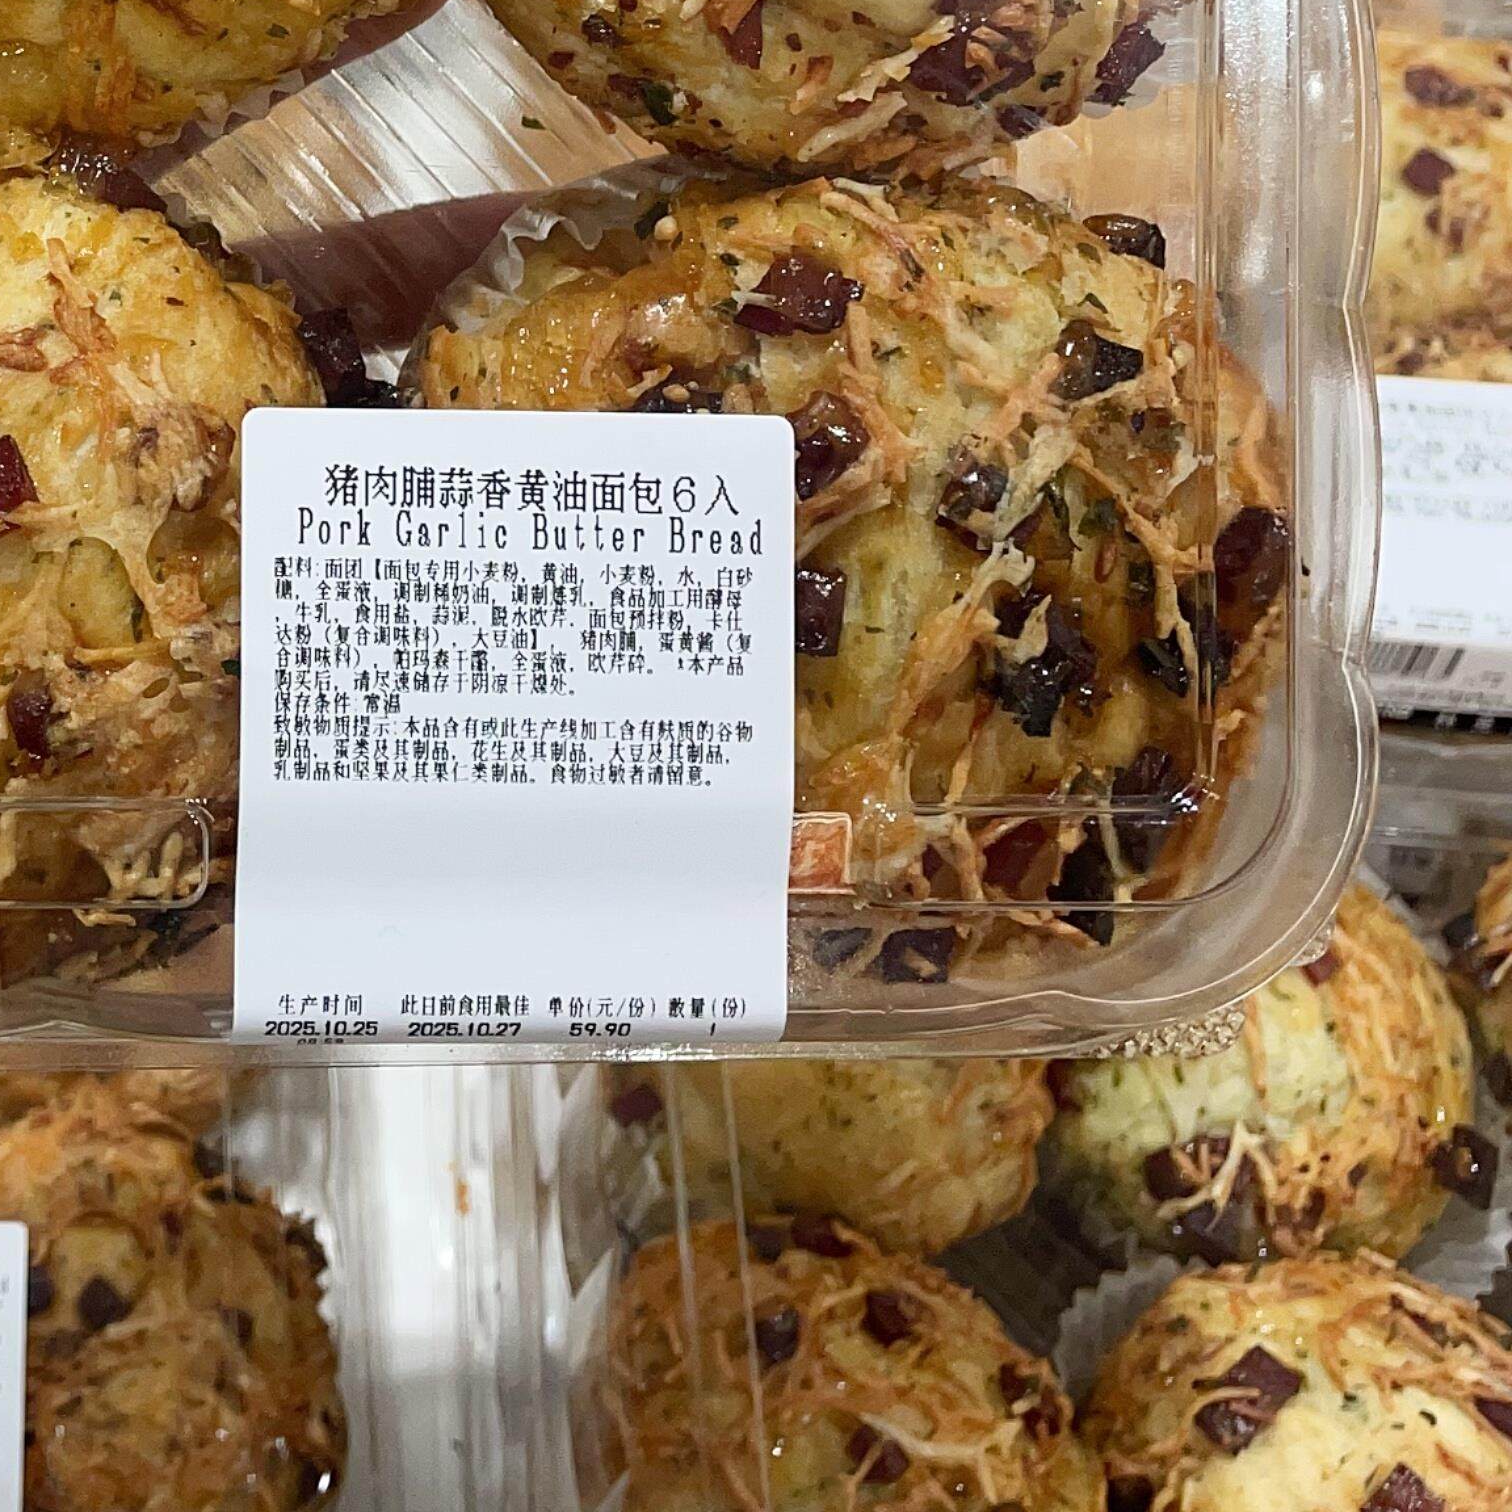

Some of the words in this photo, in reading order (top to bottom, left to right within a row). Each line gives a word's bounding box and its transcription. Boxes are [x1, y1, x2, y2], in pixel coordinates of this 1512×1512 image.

[325, 463, 740, 515] 猪肉脯蒜香黄油面包6入
[297, 506, 371, 546] Pork
[395, 509, 508, 549] Garlic
[532, 513, 645, 552] Butter
[668, 516, 763, 555] Bread
[278, 994, 363, 1016] 生产时间
[400, 994, 530, 1017] 此日前食用最佳
[264, 1020, 378, 1036] 2025.10.25
[407, 1021, 522, 1037] 2025.10.27
[569, 1022, 632, 1037] 59.90
[709, 1022, 716, 1037] 1
